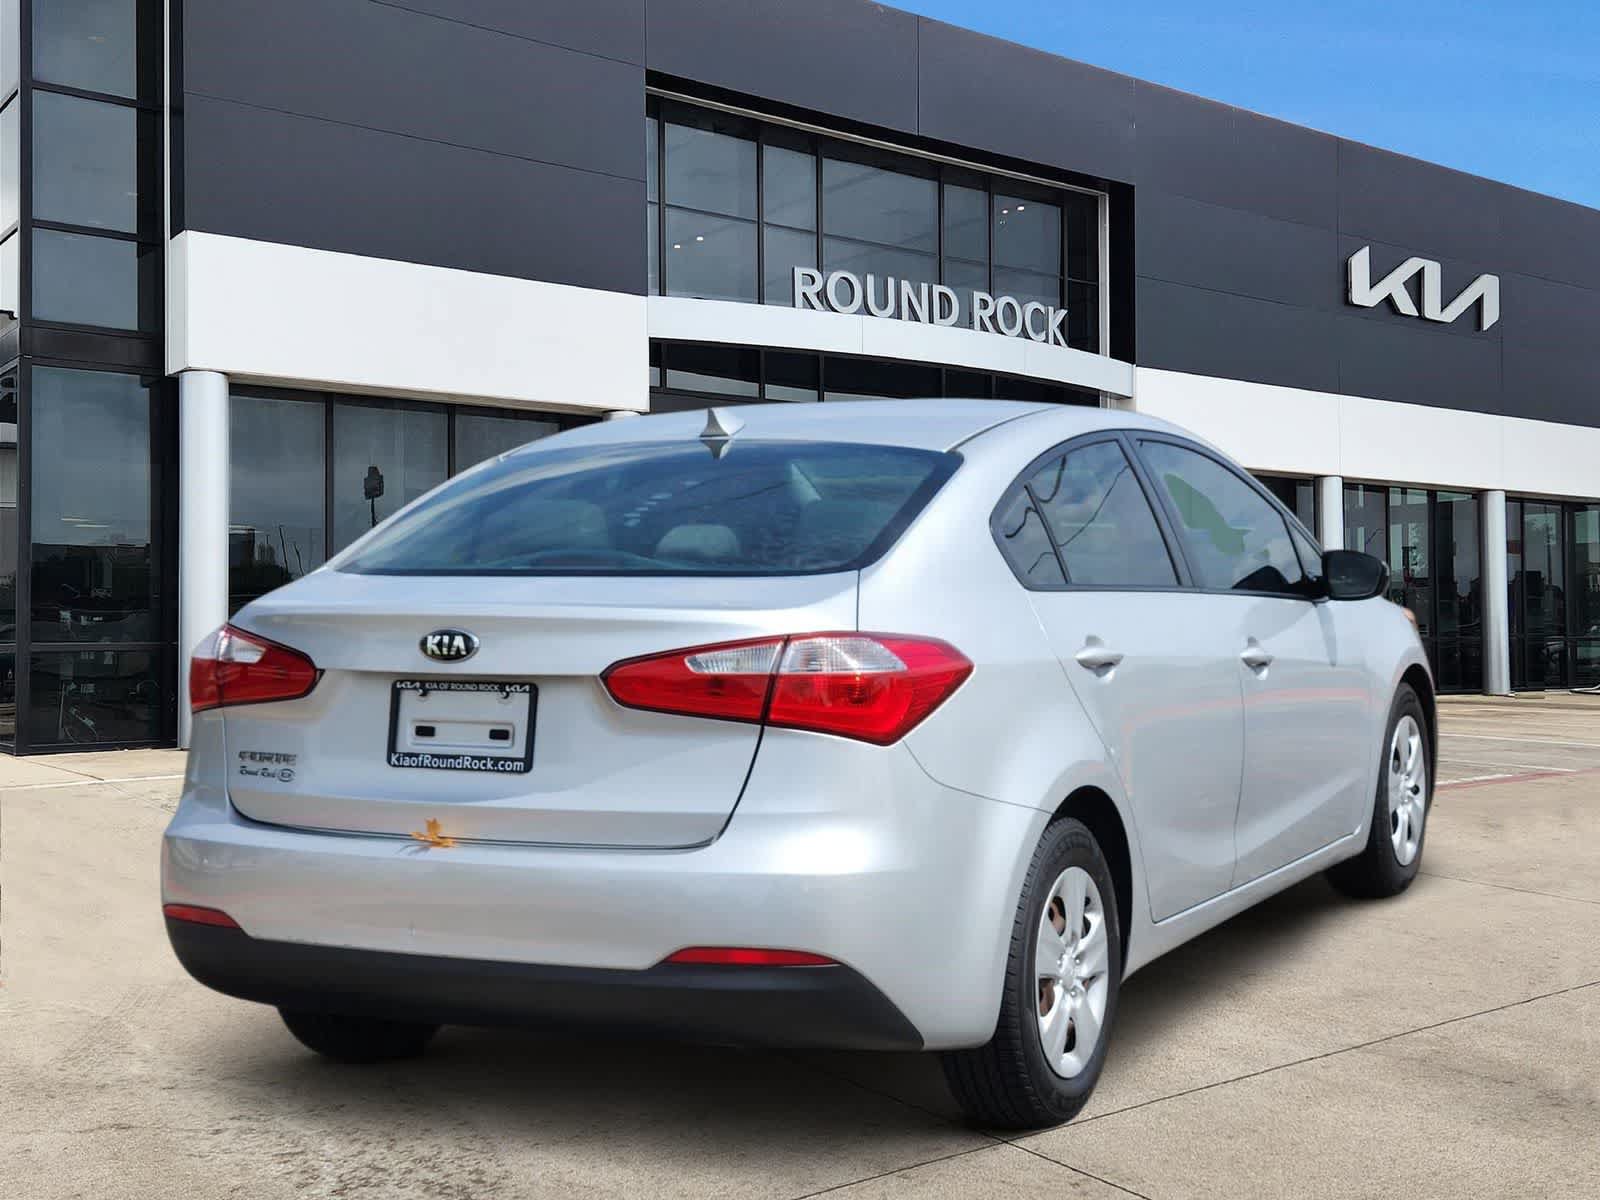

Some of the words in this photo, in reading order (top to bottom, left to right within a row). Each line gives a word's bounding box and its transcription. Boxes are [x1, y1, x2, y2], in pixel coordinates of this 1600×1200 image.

[792, 266, 960, 327] ROUND
[972, 290, 1069, 348] ROCK
[426, 635, 467, 655] KIA
[390, 753, 524, 772] KiaofRoundRock.com
